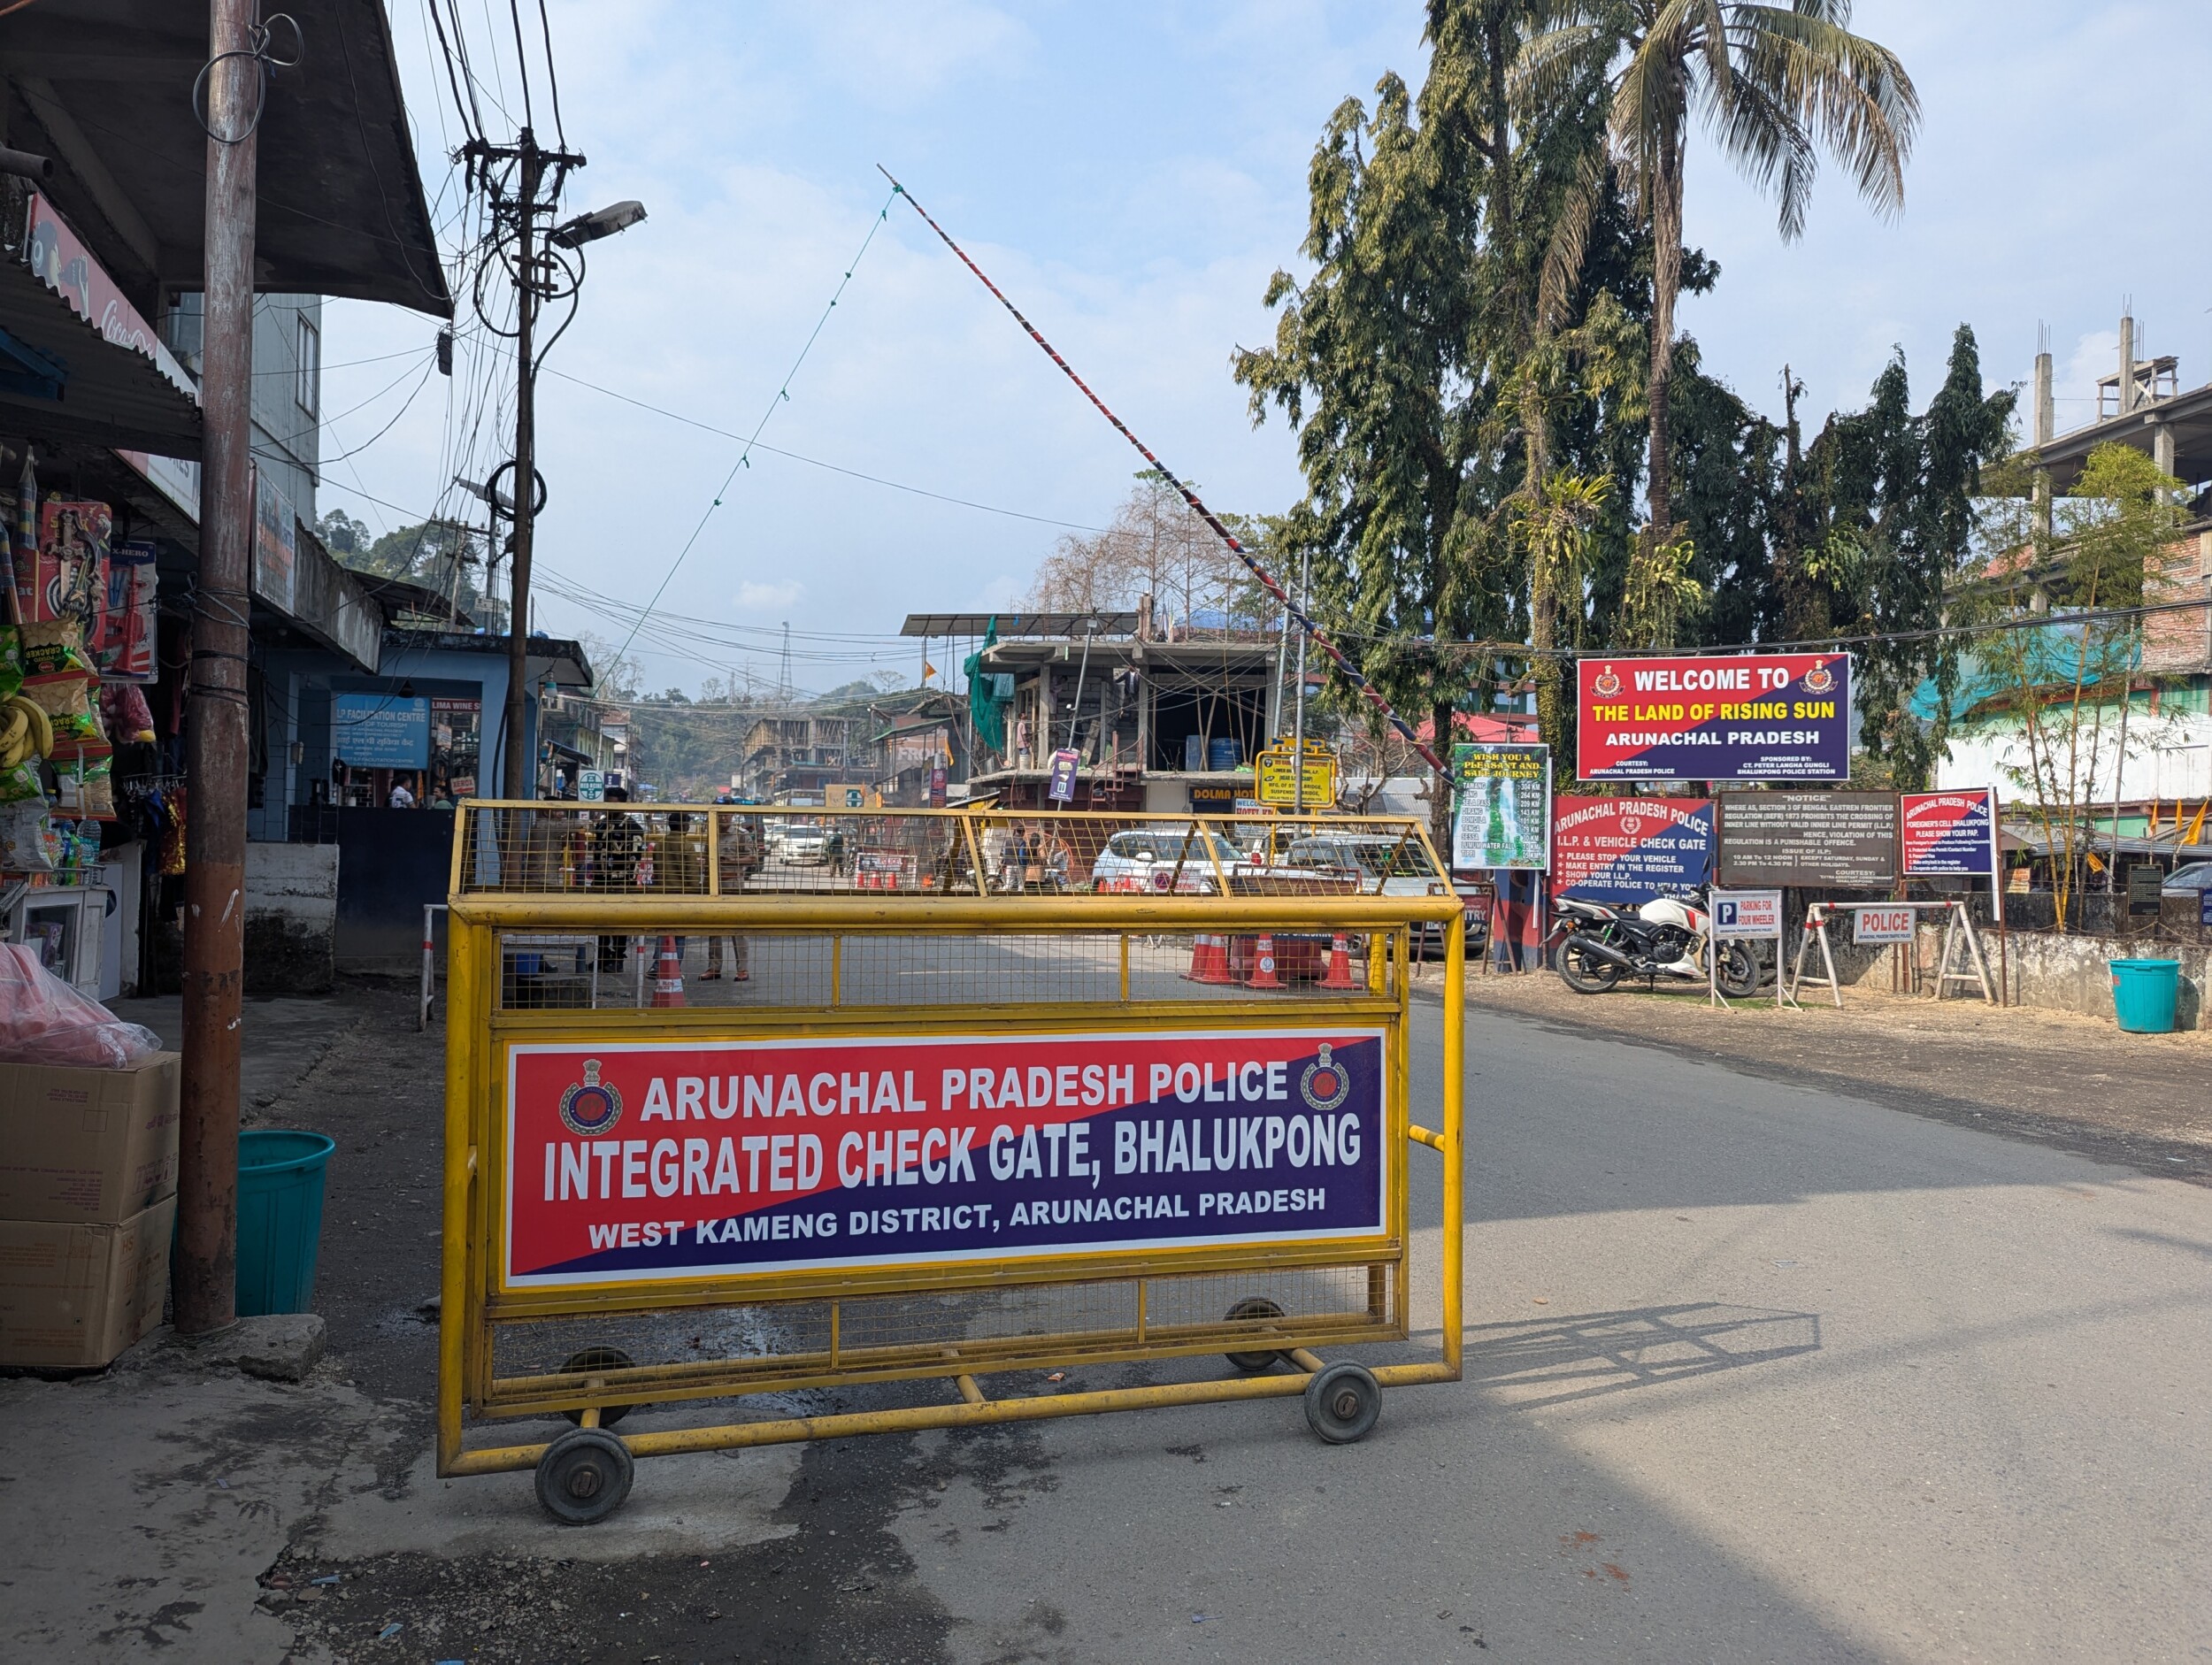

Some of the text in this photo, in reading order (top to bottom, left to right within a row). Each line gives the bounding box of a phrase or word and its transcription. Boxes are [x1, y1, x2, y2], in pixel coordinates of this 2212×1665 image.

[111, 548, 149, 557] X-HERO
[26, 646, 60, 658] CRACKER
[1634, 668, 1789, 691] WELCOME TO
[402, 711, 425, 722] CENTRE
[1593, 702, 1834, 721] THE LAND OF RISING SUN
[1606, 732, 1819, 746] ARUNACHAL PRADESH
[1194, 789, 1231, 800] DOLMA
[1907, 797, 1987, 820] ARUNACHAL PRADESH POLICE
[1555, 802, 1709, 836] ARUNACHAL PRADESH POLICE
[1557, 836, 1706, 849] I.L.P. & VEHICLE CHECK GATE
[1643, 855, 1676, 863] VEHICLE
[1646, 864, 1684, 873] REGISTER
[1740, 901, 1772, 911] PARKING FOR
[1722, 905, 1732, 923] P
[1739, 915, 1774, 925] FOUR WHEELER
[1863, 913, 1909, 932] POLICE
[640, 1070, 926, 1121] ARUNACHAL
[941, 1064, 1134, 1110] PRADESH
[1149, 1061, 1288, 1103] POLICE
[543, 1113, 1361, 1201] INTEGRATED CHECK GATE, BHALUKPONG
[588, 1188, 1325, 1249] WEST KAMENG DISTRICT, ARUNACHAL PRADESH
